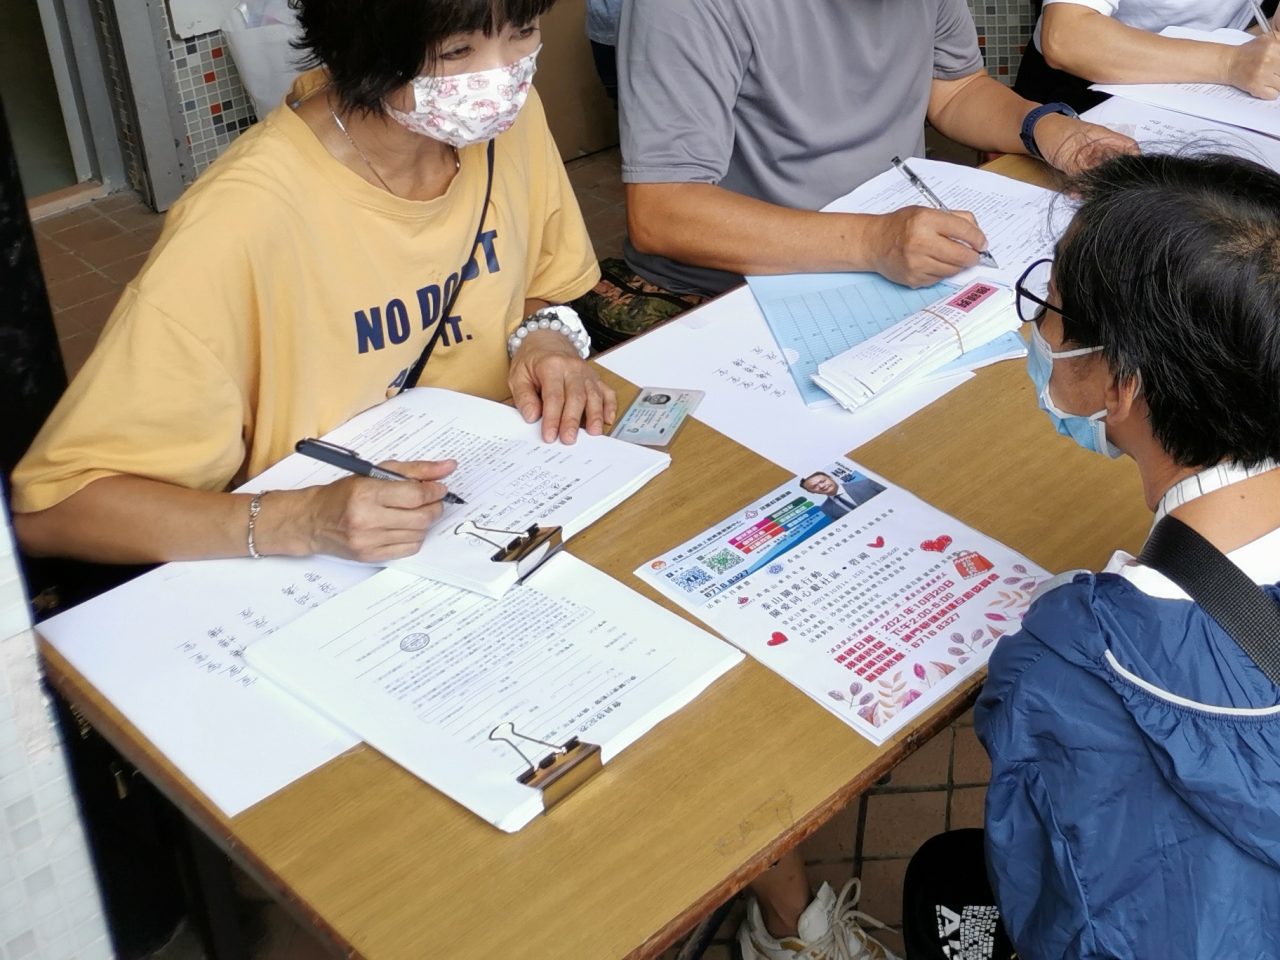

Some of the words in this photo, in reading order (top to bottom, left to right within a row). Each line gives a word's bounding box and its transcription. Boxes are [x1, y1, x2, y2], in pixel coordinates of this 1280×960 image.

[354, 298, 411, 354] NO
[725, 568, 751, 584] 8327
[757, 569, 825, 611] 泰山關愛行動
[935, 612, 962, 630] 8327
[576, 700, 622, 733] 會員登記表
[936, 905, 944, 938] BLACK
